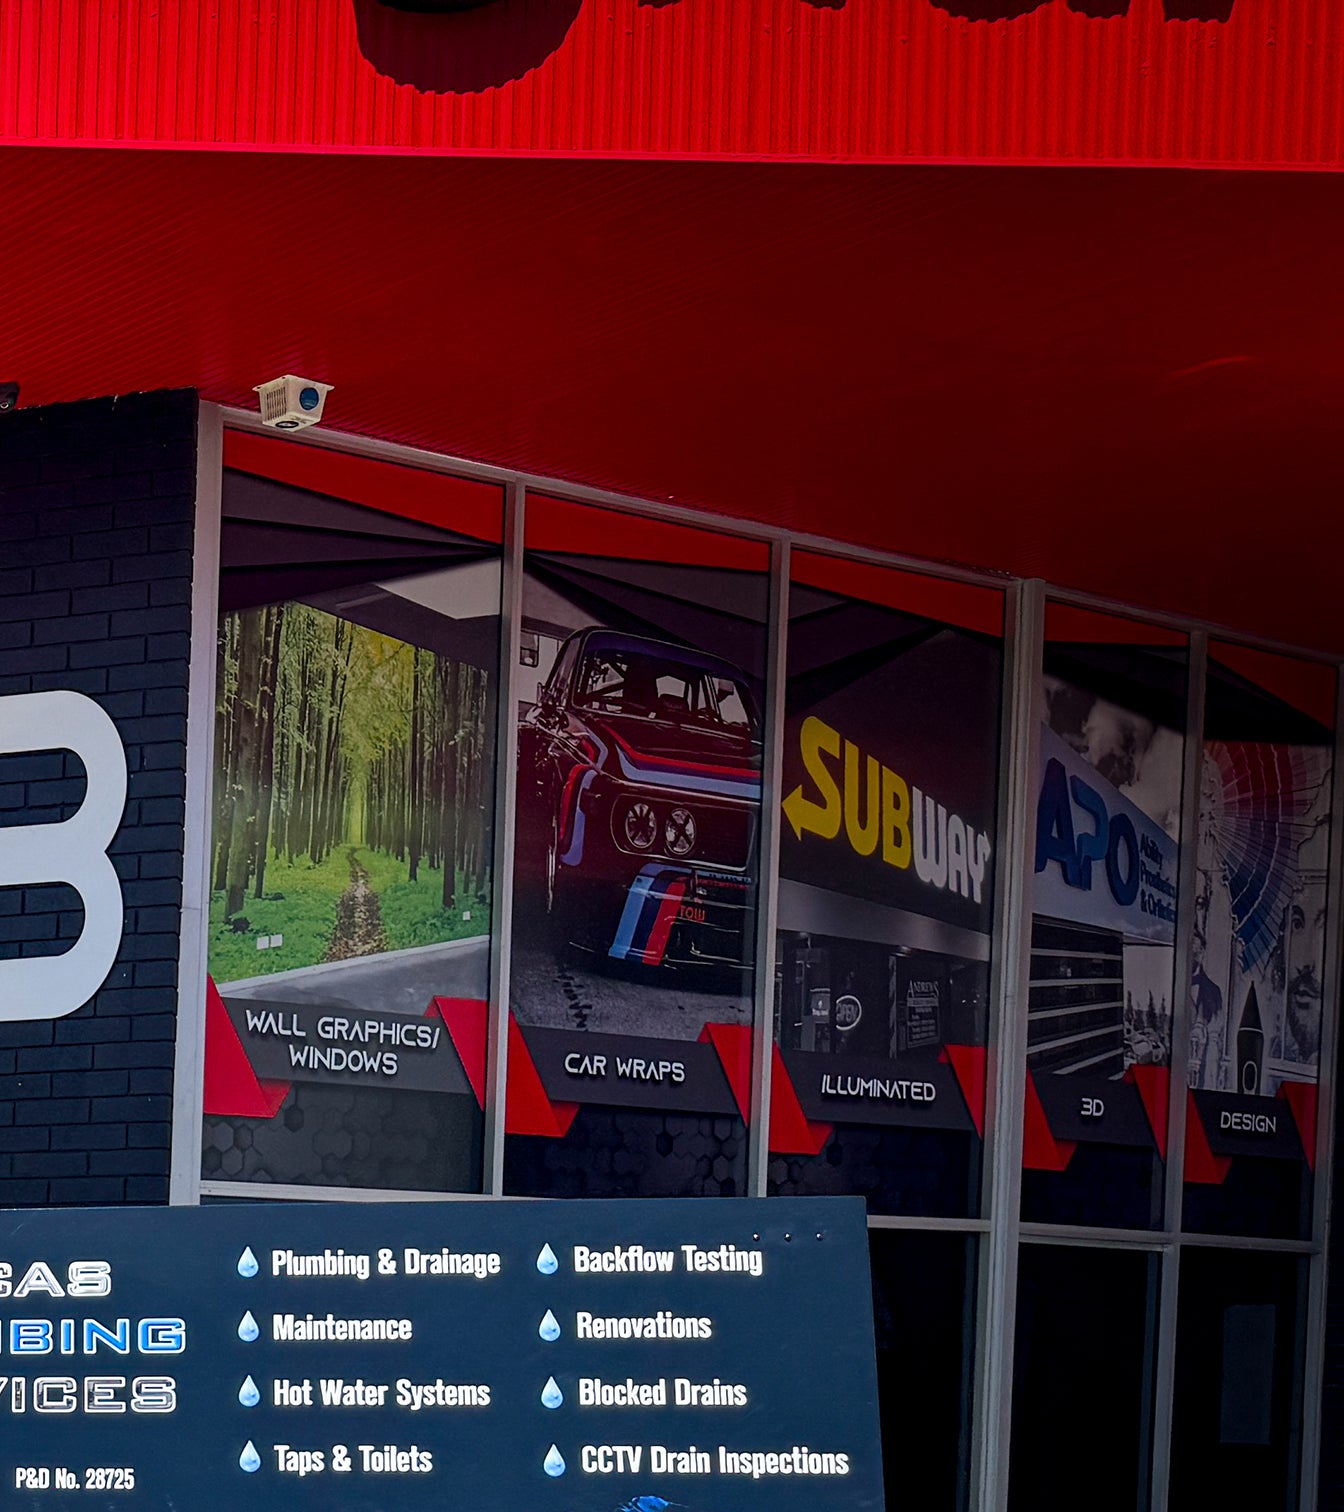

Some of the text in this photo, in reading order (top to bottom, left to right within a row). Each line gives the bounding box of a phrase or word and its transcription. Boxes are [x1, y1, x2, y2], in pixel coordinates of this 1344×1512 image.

[781, 716, 991, 905] SUBWAY
[1035, 757, 1140, 907] APO
[246, 1009, 440, 1049] WALL GRAPHICS/
[289, 1045, 398, 1076] WINDOWS
[564, 1053, 686, 1083] CAR WRAPS
[821, 1074, 936, 1102] ILLUMINATED
[1080, 1098, 1105, 1118] 3D
[1220, 1111, 1277, 1134] DESIGN
[272, 1248, 501, 1280] Plumbing & Drainage
[573, 1244, 763, 1276] Backflow Testing
[273, 1313, 413, 1341] Maintenance
[576, 1311, 712, 1339] Renovations
[273, 1378, 491, 1411] Hot Water Systems
[578, 1377, 748, 1406] Blocked Drains
[273, 1444, 433, 1477] Taps & Toilets
[581, 1445, 850, 1479] CCTV Drain Inspections
[15, 1467, 135, 1490] P&D No. 28725
